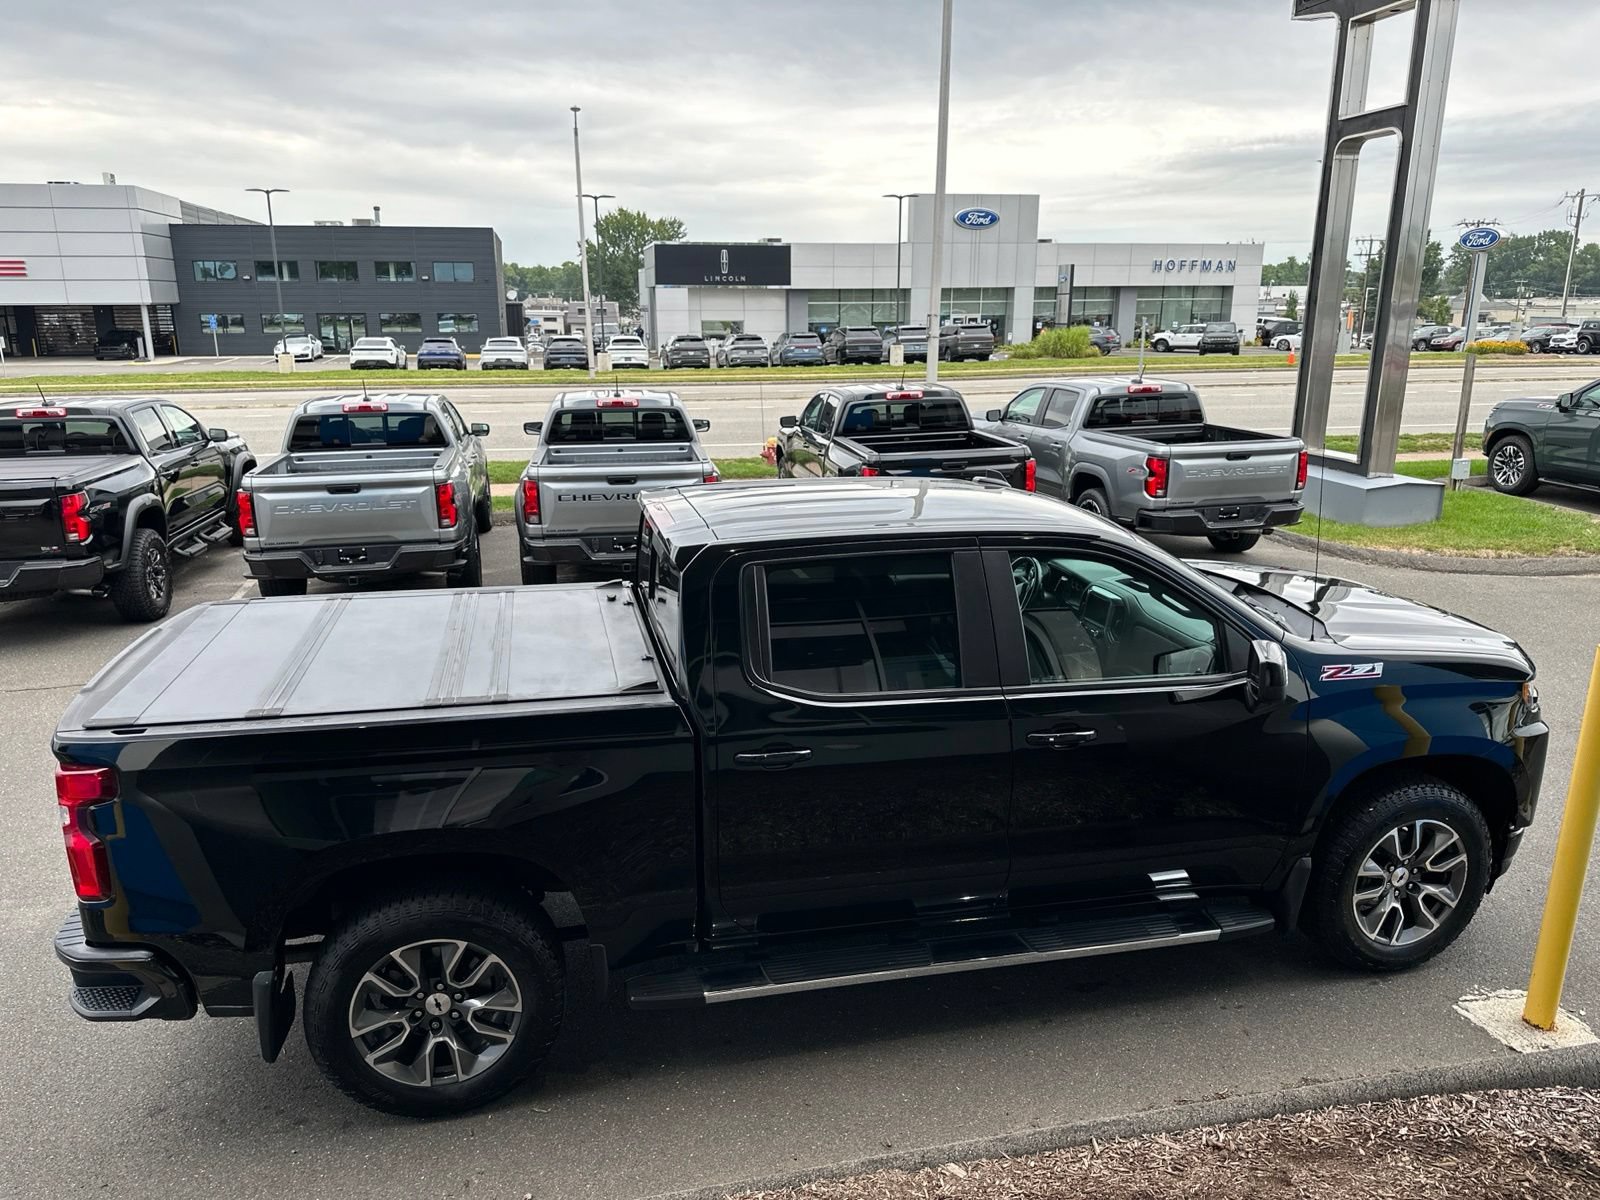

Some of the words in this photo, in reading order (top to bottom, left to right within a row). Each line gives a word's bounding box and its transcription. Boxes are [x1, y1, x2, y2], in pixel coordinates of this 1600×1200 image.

[964, 211, 992, 225] Ford
[1466, 231, 1493, 246] Ford
[1153, 258, 1237, 272] HOFFMAN
[1185, 465, 1288, 479] CHEVROLET
[274, 500, 416, 515] CHEVROLET
[1319, 662, 1384, 682] Z71
